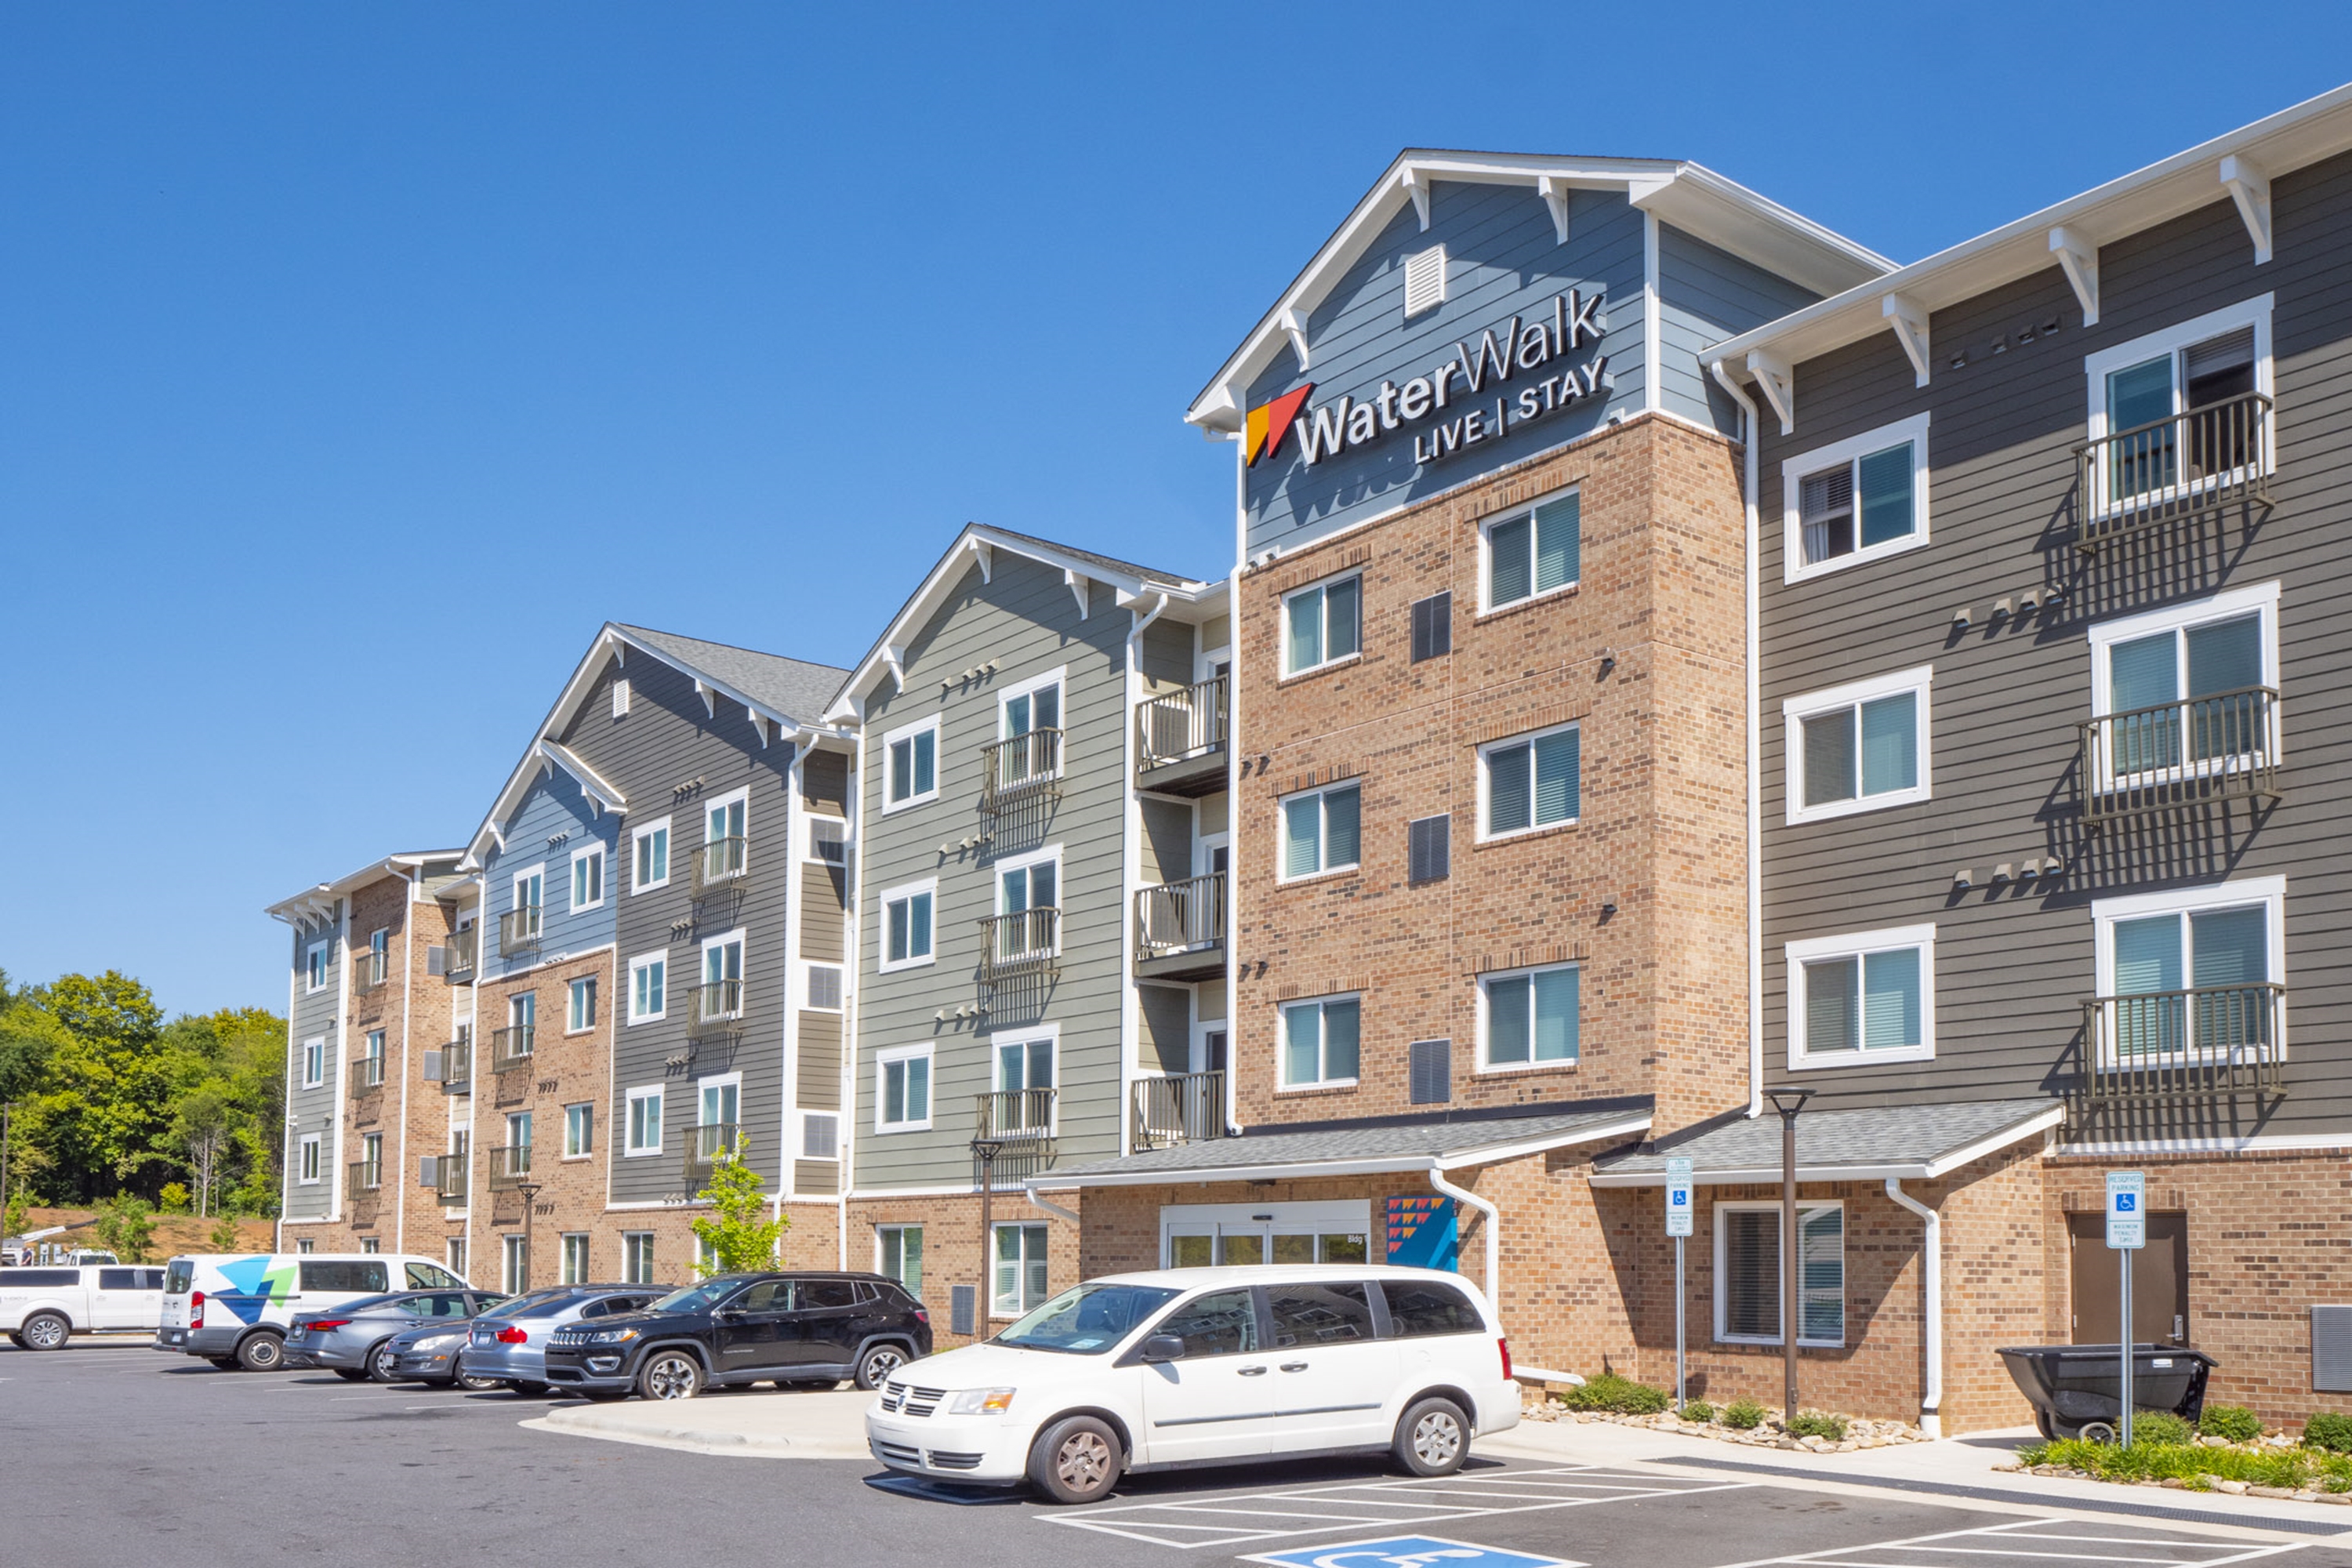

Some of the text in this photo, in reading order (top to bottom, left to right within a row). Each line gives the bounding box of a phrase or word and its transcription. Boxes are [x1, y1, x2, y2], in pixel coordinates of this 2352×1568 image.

[1295, 289, 1606, 466] WaterWalk
[1415, 410, 1486, 464] LIVE
[1519, 357, 1606, 420] STAY
